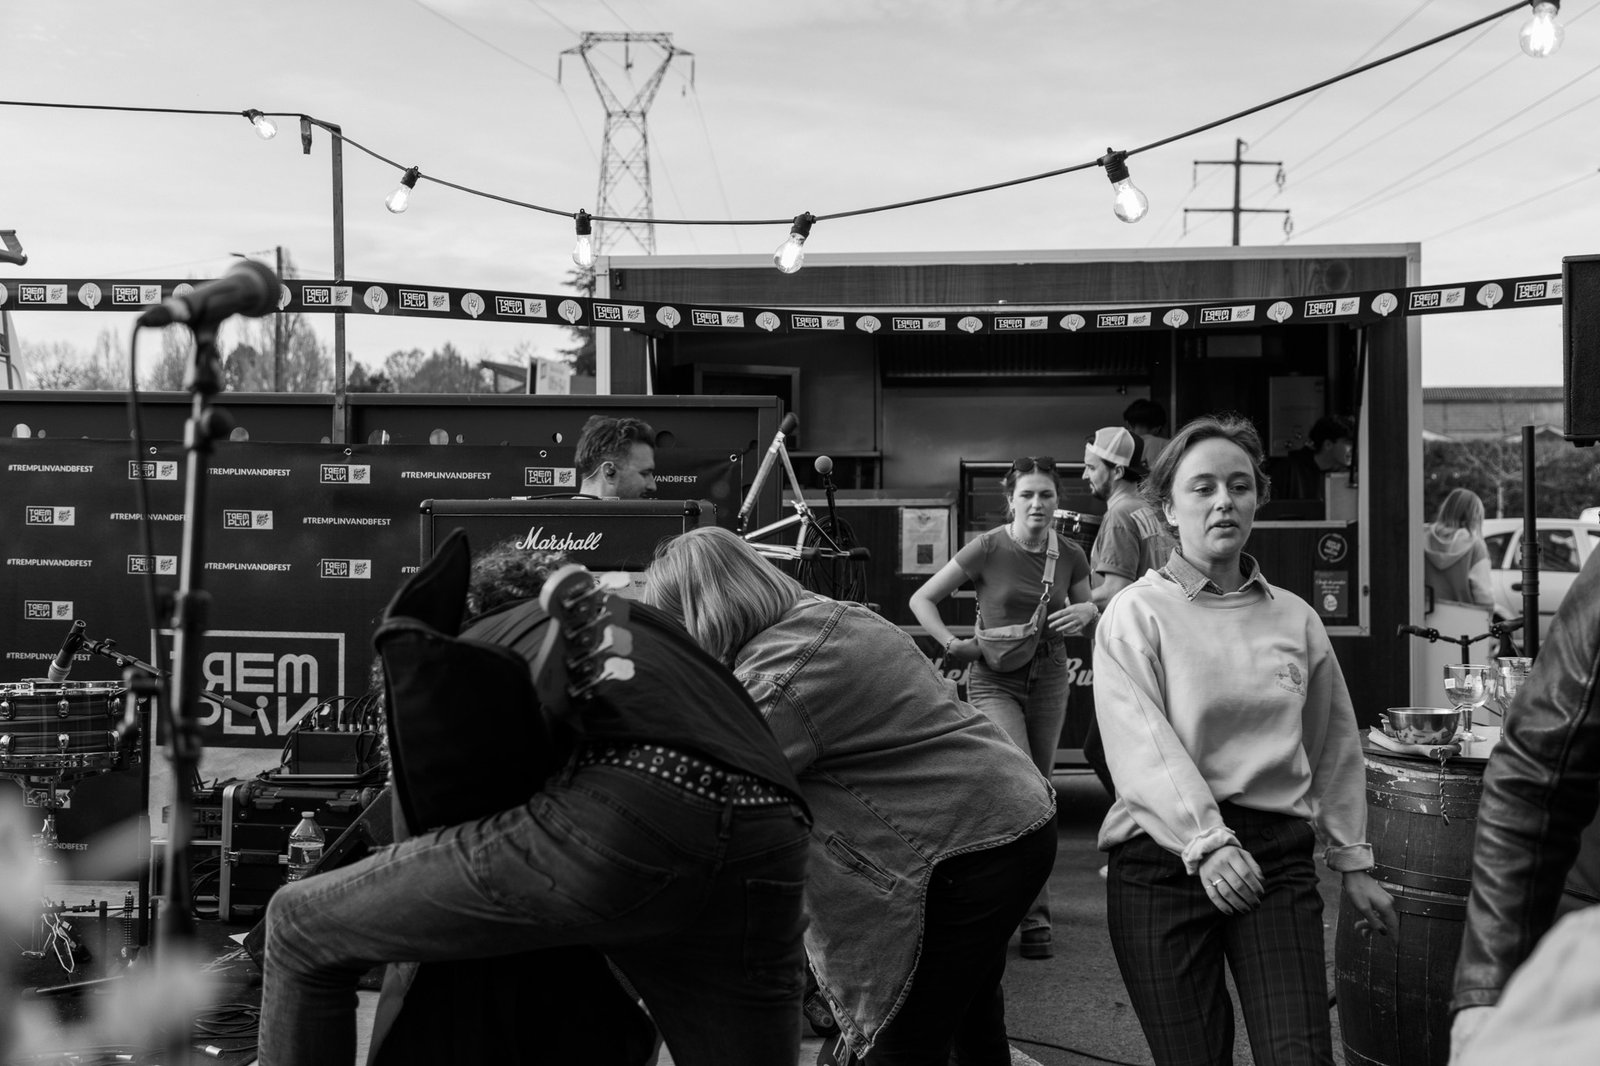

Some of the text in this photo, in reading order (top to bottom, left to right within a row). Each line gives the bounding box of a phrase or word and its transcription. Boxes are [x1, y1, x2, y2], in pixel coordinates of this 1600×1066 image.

[8, 464, 94, 472] #TREMPLINVANDBFEST
[206, 468, 291, 476] TREMPLINVANDBFEST
[401, 471, 492, 479] #TREMPLINVANDBFEST
[303, 517, 391, 525] #TREMPLINVANDBFEST
[515, 526, 602, 550] Marshall
[7, 558, 93, 566] #TREMPLINVANDBFEST
[204, 563, 291, 571] #TREMPLINVANDBFEST
[170, 652, 318, 694] REM
